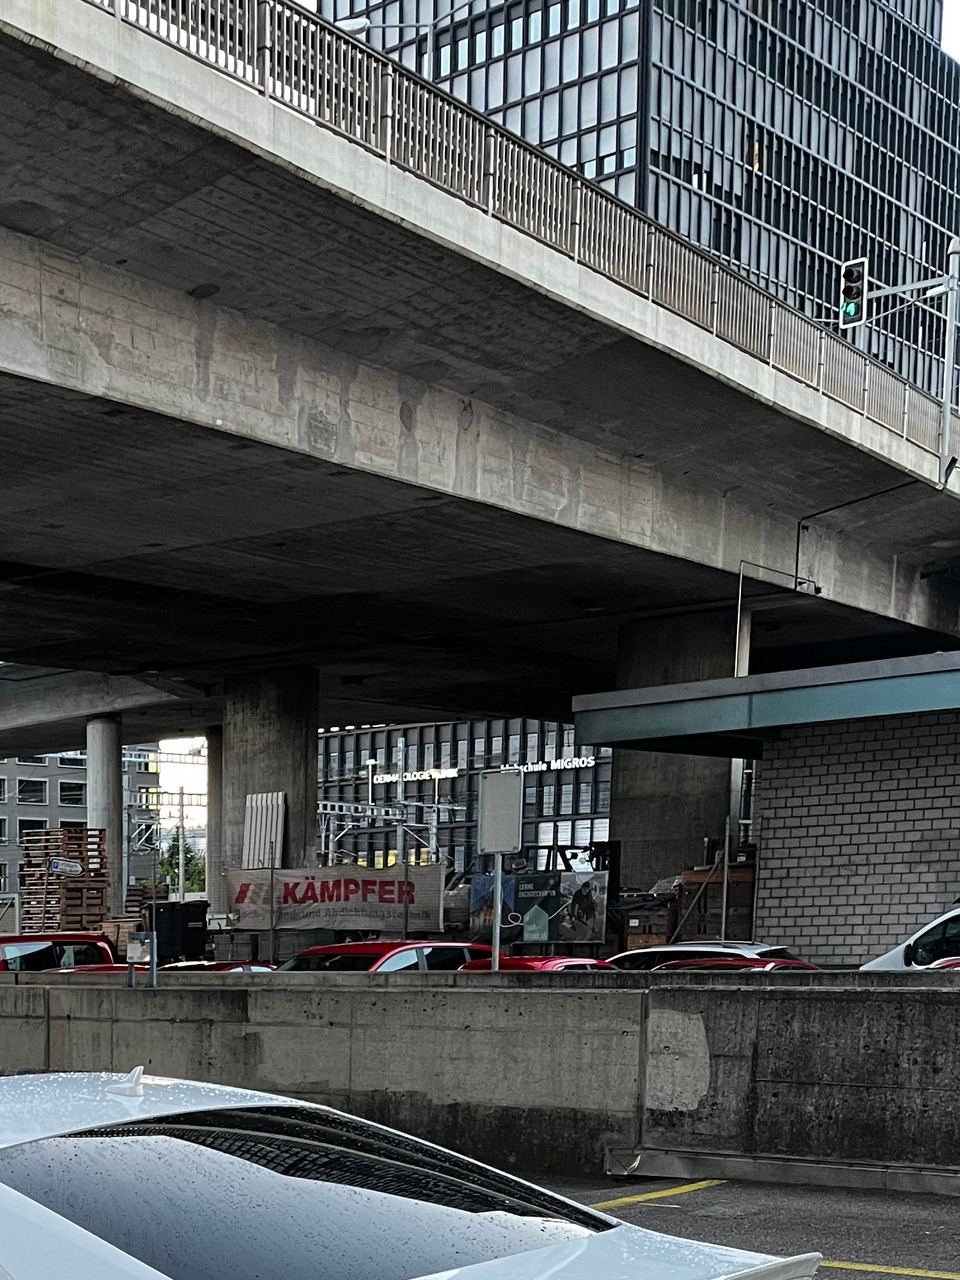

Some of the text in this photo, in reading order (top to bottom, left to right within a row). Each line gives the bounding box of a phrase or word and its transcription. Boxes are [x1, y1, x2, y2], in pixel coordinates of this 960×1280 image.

[550, 756, 596, 771] MIGROS
[282, 876, 416, 905] KÄMPFER
[324, 907, 431, 921] Abdichtungstehnik
